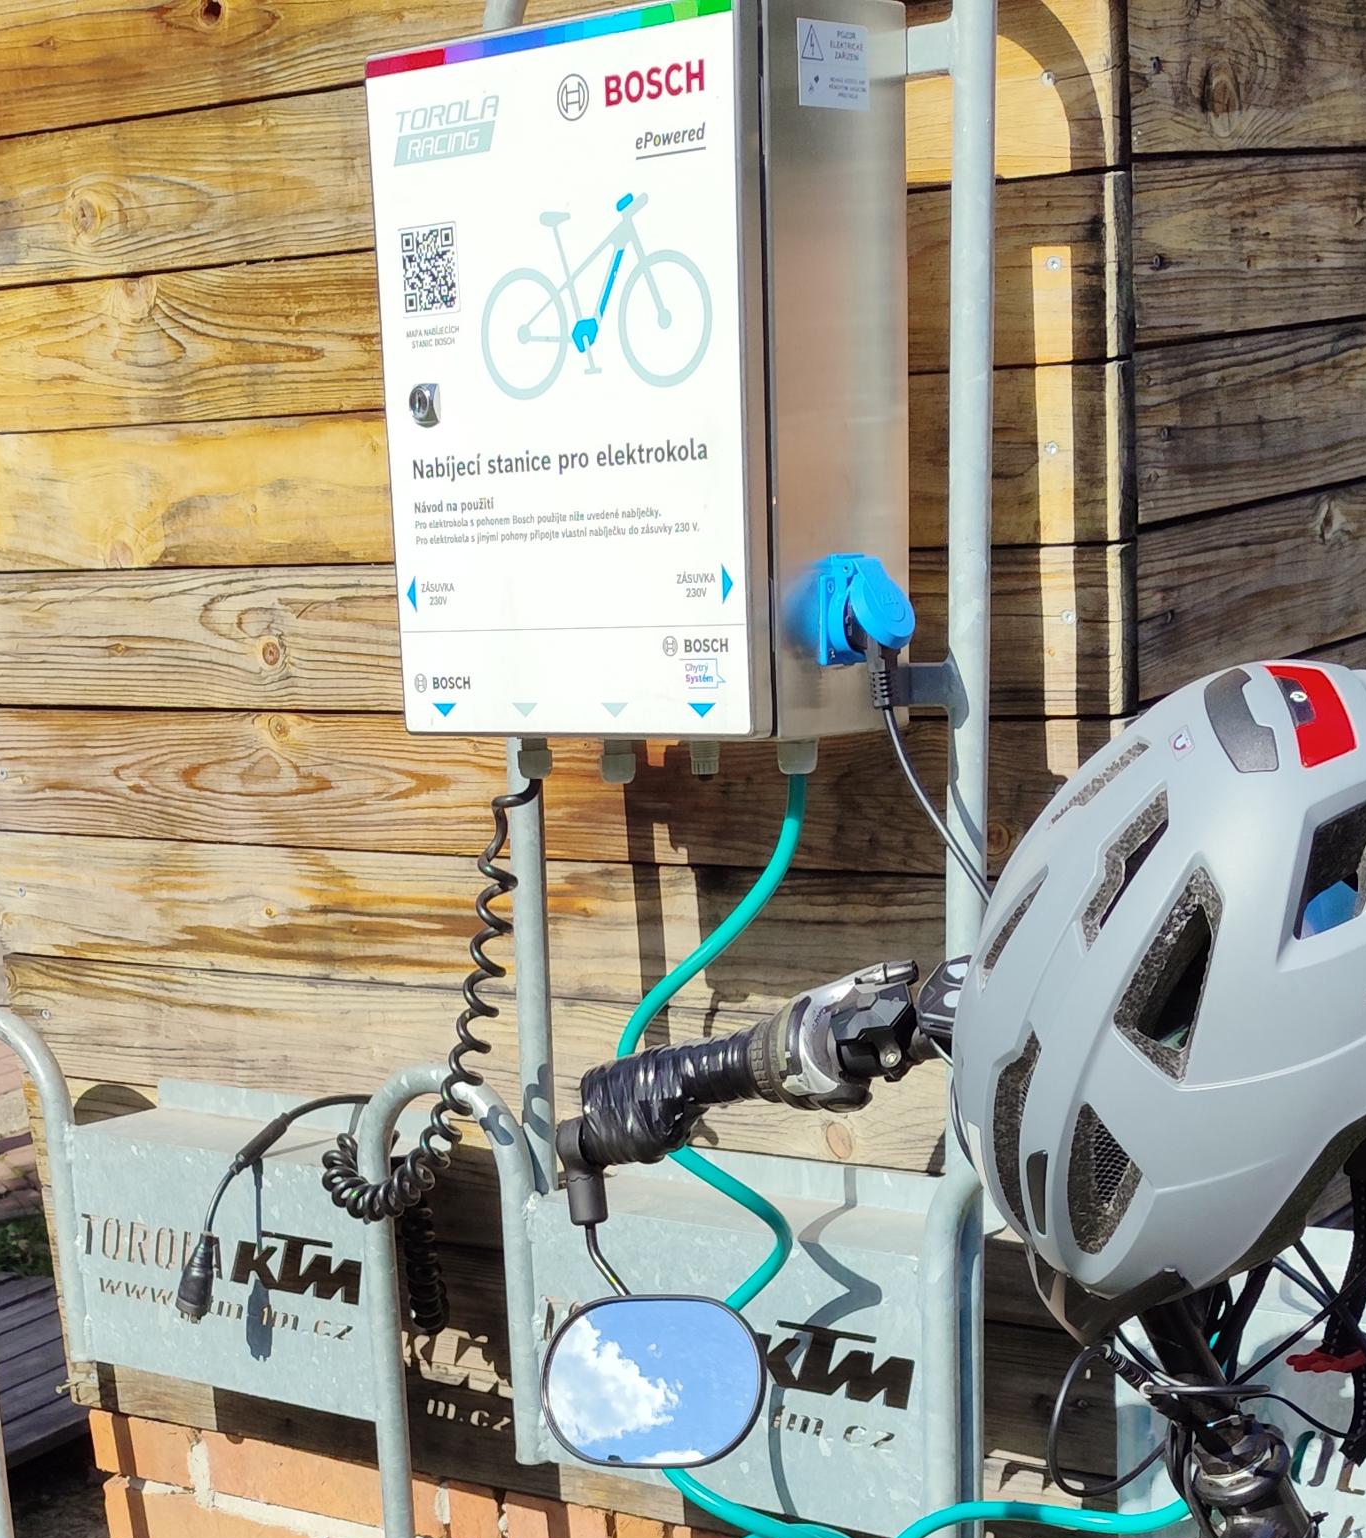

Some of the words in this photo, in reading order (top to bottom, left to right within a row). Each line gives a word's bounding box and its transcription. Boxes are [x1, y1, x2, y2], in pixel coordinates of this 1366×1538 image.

[604, 59, 705, 107] BOSCH
[395, 95, 500, 133] TOROLA
[406, 128, 480, 160] RACING
[635, 122, 706, 151] ePowered
[412, 453, 481, 482] Nabíjecí
[487, 450, 552, 475] stanice
[558, 452, 589, 475] pro
[596, 437, 708, 467] elektrokola
[414, 500, 444, 515] Návod
[446, 502, 458, 513] na
[460, 497, 494, 514] použití
[415, 520, 428, 530] Pro
[429, 517, 469, 529] elektrokola
[476, 516, 511, 528] pohonem
[512, 513, 535, 525] Bosch
[416, 535, 428, 545] Pro
[429, 532, 470, 545] elektrokola
[501, 530, 528, 543] pohony
[628, 525, 639, 535] do
[641, 523, 674, 536] zásuvky
[675, 522, 690, 533] 230
[676, 571, 716, 585] ZÁSUVKA
[421, 581, 456, 593] ZÁSUVKA
[685, 587, 707, 598] 230V
[429, 595, 448, 606] 230V
[683, 638, 729, 653] BOSCH
[685, 662, 710, 675] Chytrý
[432, 675, 472, 690] BOSCH
[685, 673, 715, 685] Systém
[230, 1229, 363, 1306] KTM
[753, 1319, 916, 1411] KTM
